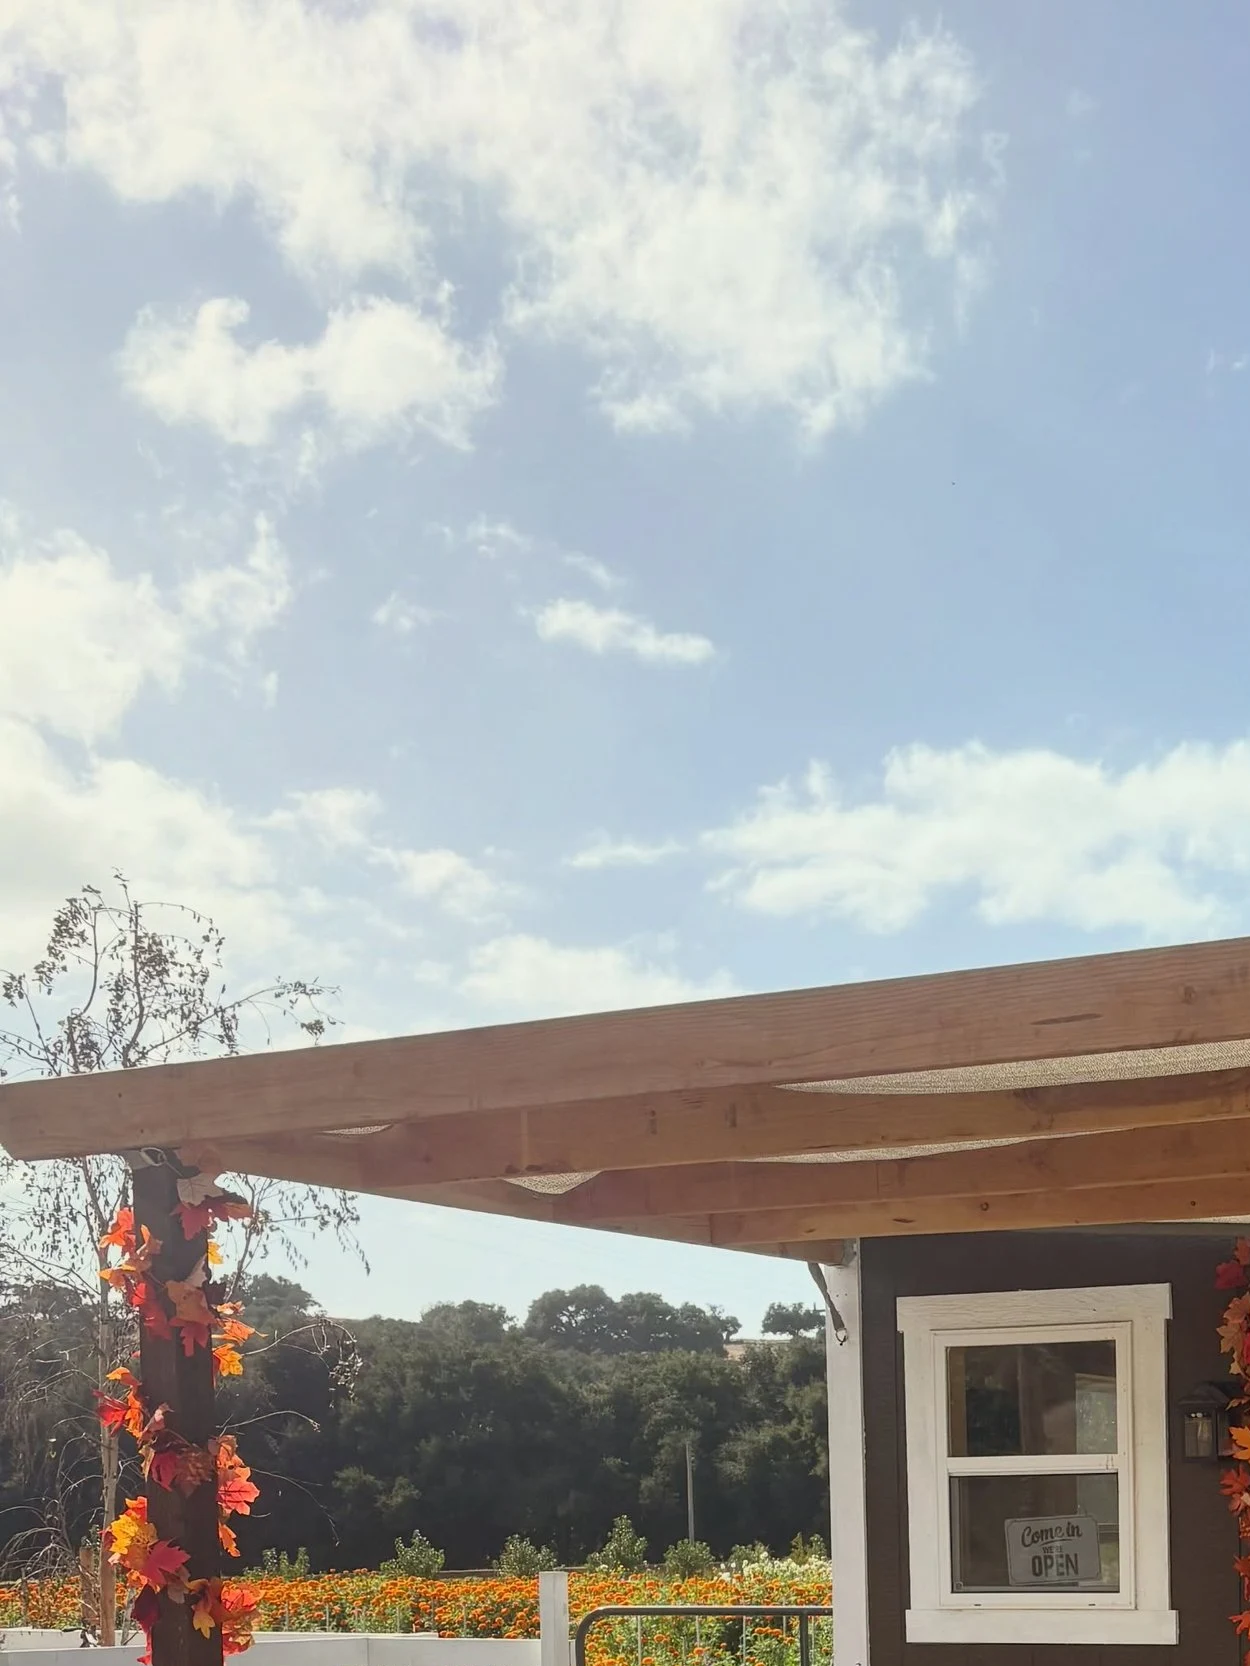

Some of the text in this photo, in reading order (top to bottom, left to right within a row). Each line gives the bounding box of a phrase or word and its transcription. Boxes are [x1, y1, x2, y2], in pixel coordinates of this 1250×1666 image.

[1021, 1521, 1083, 1548] Come in
[1031, 1553, 1079, 1577] OPEN
